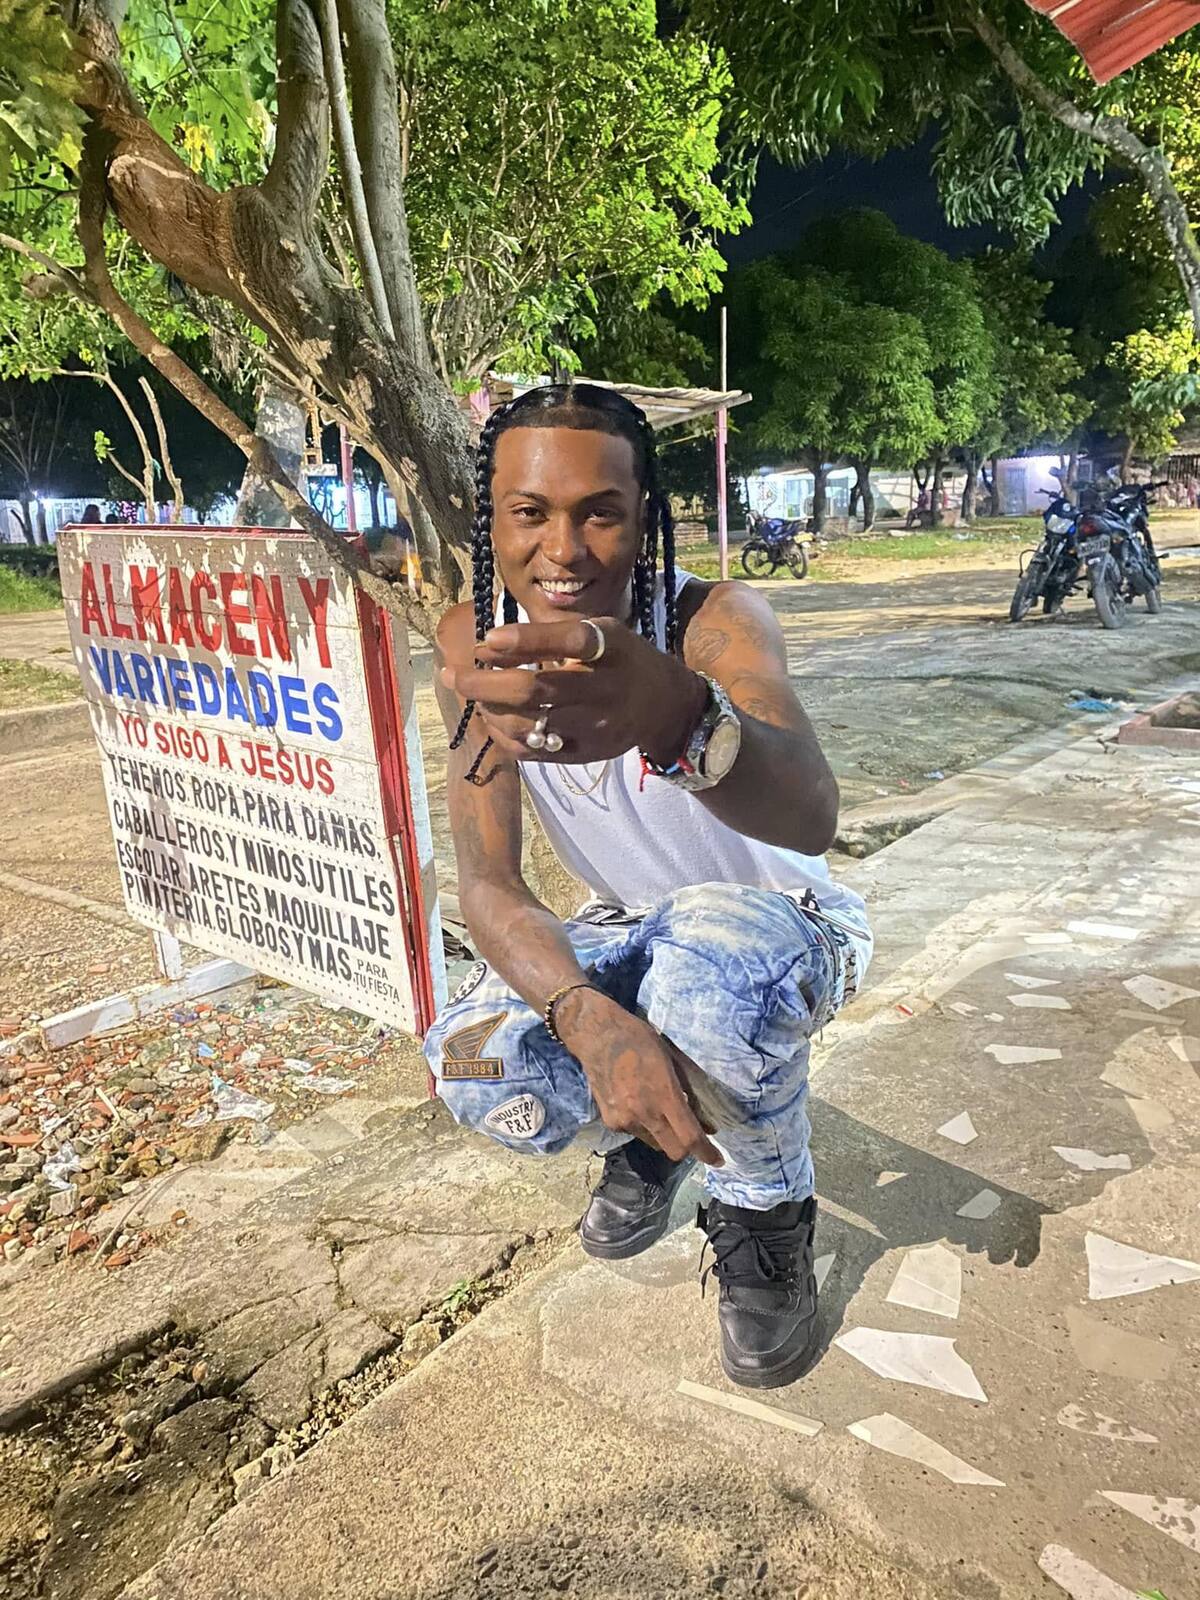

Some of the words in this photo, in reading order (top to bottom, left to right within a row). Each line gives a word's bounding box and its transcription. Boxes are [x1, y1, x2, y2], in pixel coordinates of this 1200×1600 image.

[81, 561, 292, 664] ALMACEN
[297, 576, 332, 669] Y
[89, 646, 344, 742] VARIEDADES
[117, 713, 148, 749] YO
[153, 721, 210, 763] SIGO
[217, 735, 233, 771] A
[240, 741, 336, 795] JESUS
[243, 789, 298, 837] PARA
[301, 805, 381, 859] DAMAS,
[226, 832, 239, 868] Y
[308, 857, 395, 917] UTILES
[188, 862, 262, 915] ARETES
[264, 886, 392, 961] MAQUILLAJE
[291, 930, 304, 965] Y
[357, 958, 389, 980] PARA
[354, 971, 367, 988] TU
[368, 976, 400, 1002] FIESTA
[490, 1099, 535, 1124] INDUSTRY
[505, 1113, 533, 1134] F&F
